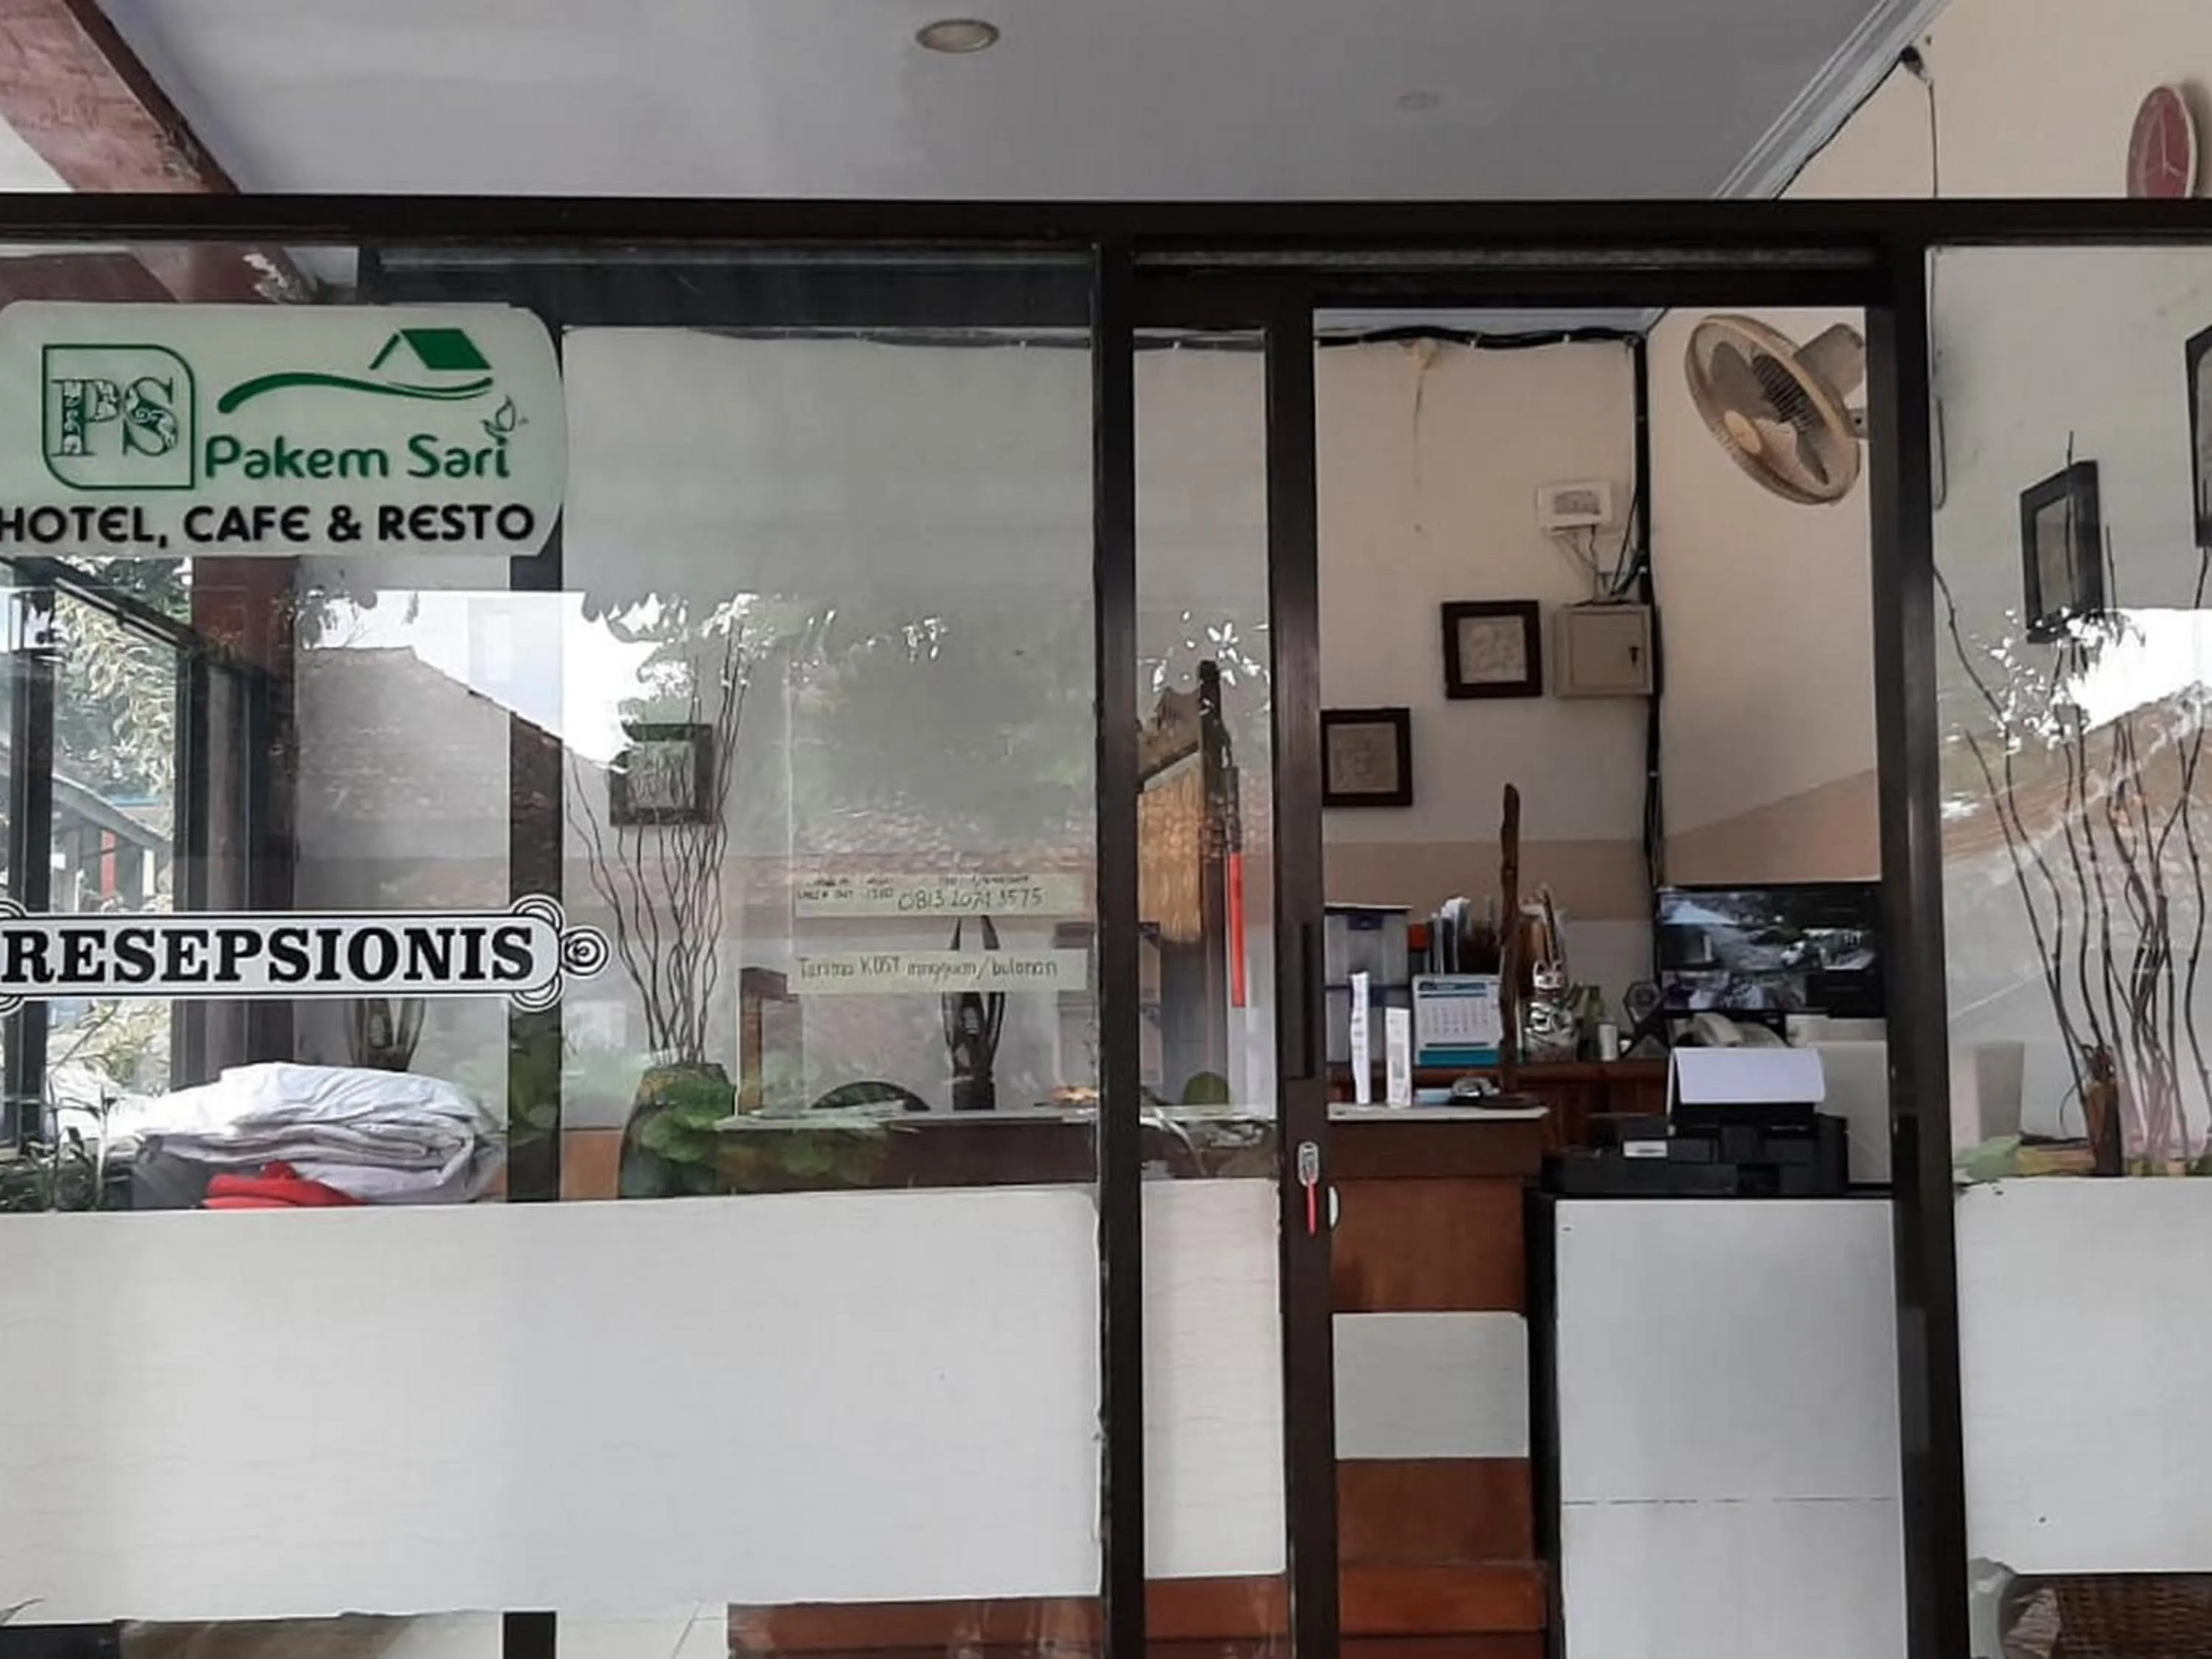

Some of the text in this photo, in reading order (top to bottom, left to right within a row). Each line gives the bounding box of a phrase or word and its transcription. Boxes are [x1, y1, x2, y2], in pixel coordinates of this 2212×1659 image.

[50, 376, 179, 457] PS
[205, 435, 510, 479] Pakem Sari
[0, 504, 535, 549] HOTEL, CAFE & RESTO
[1, 927, 535, 984] RESEPSIONIS
